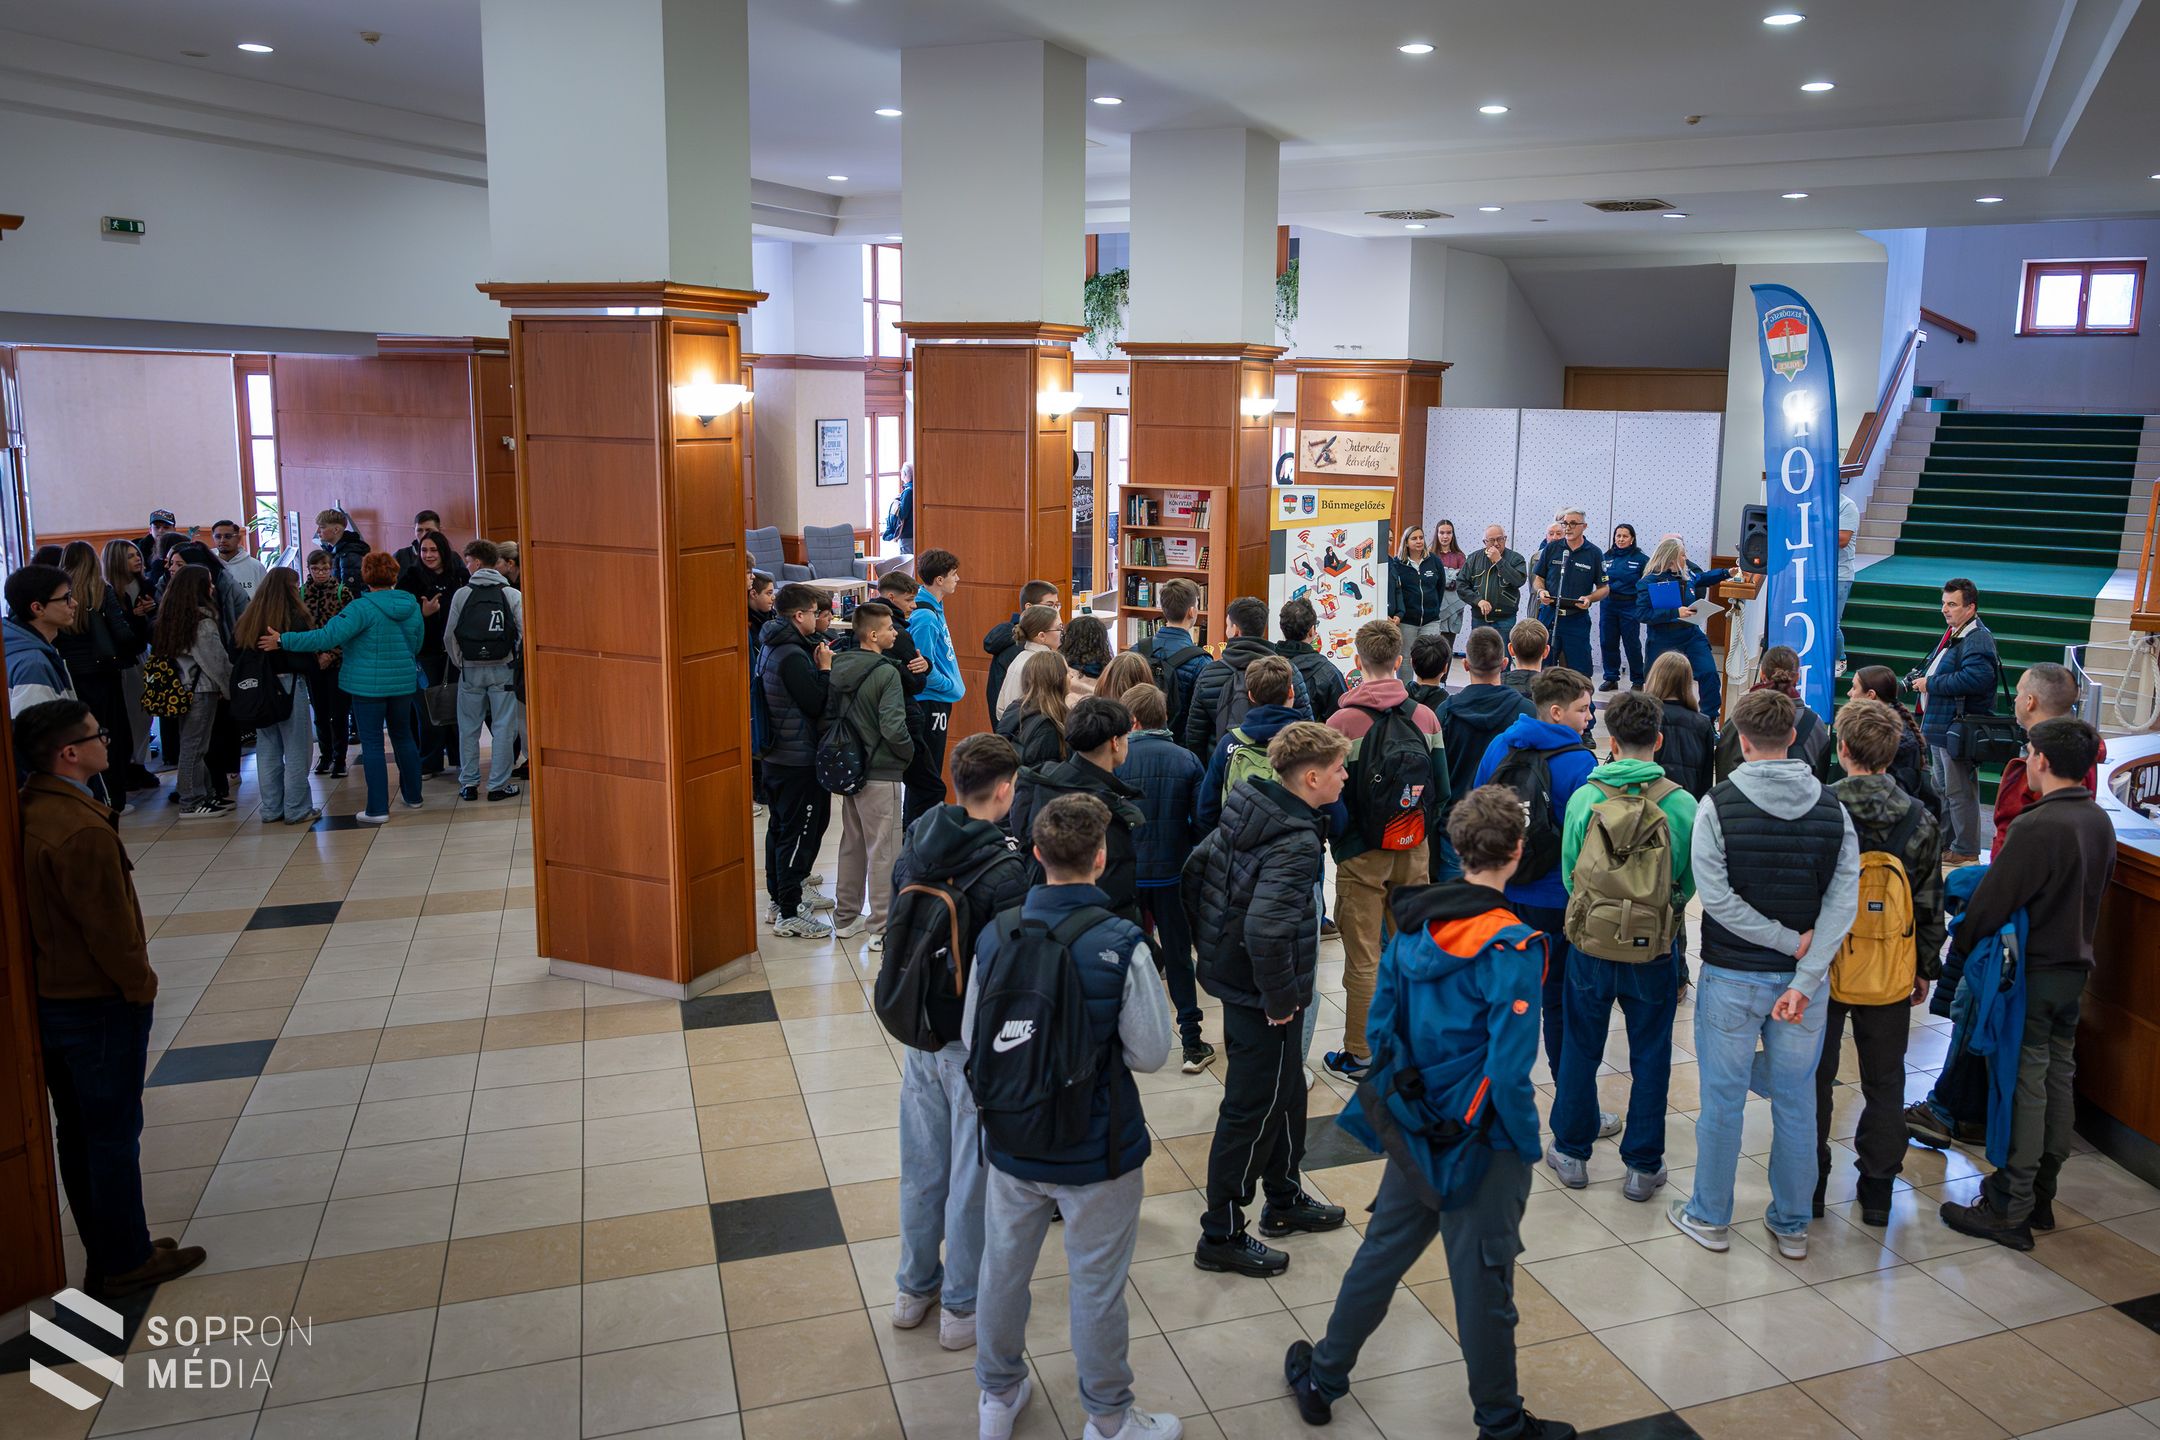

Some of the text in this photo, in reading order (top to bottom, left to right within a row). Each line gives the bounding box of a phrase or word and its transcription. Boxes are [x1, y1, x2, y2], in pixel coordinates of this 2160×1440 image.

[1321, 500, 1386, 512] Bűnmegelőzés
[489, 609, 505, 632] A
[931, 712, 947, 731] 70
[1000, 1020, 1034, 1038] NIKE
